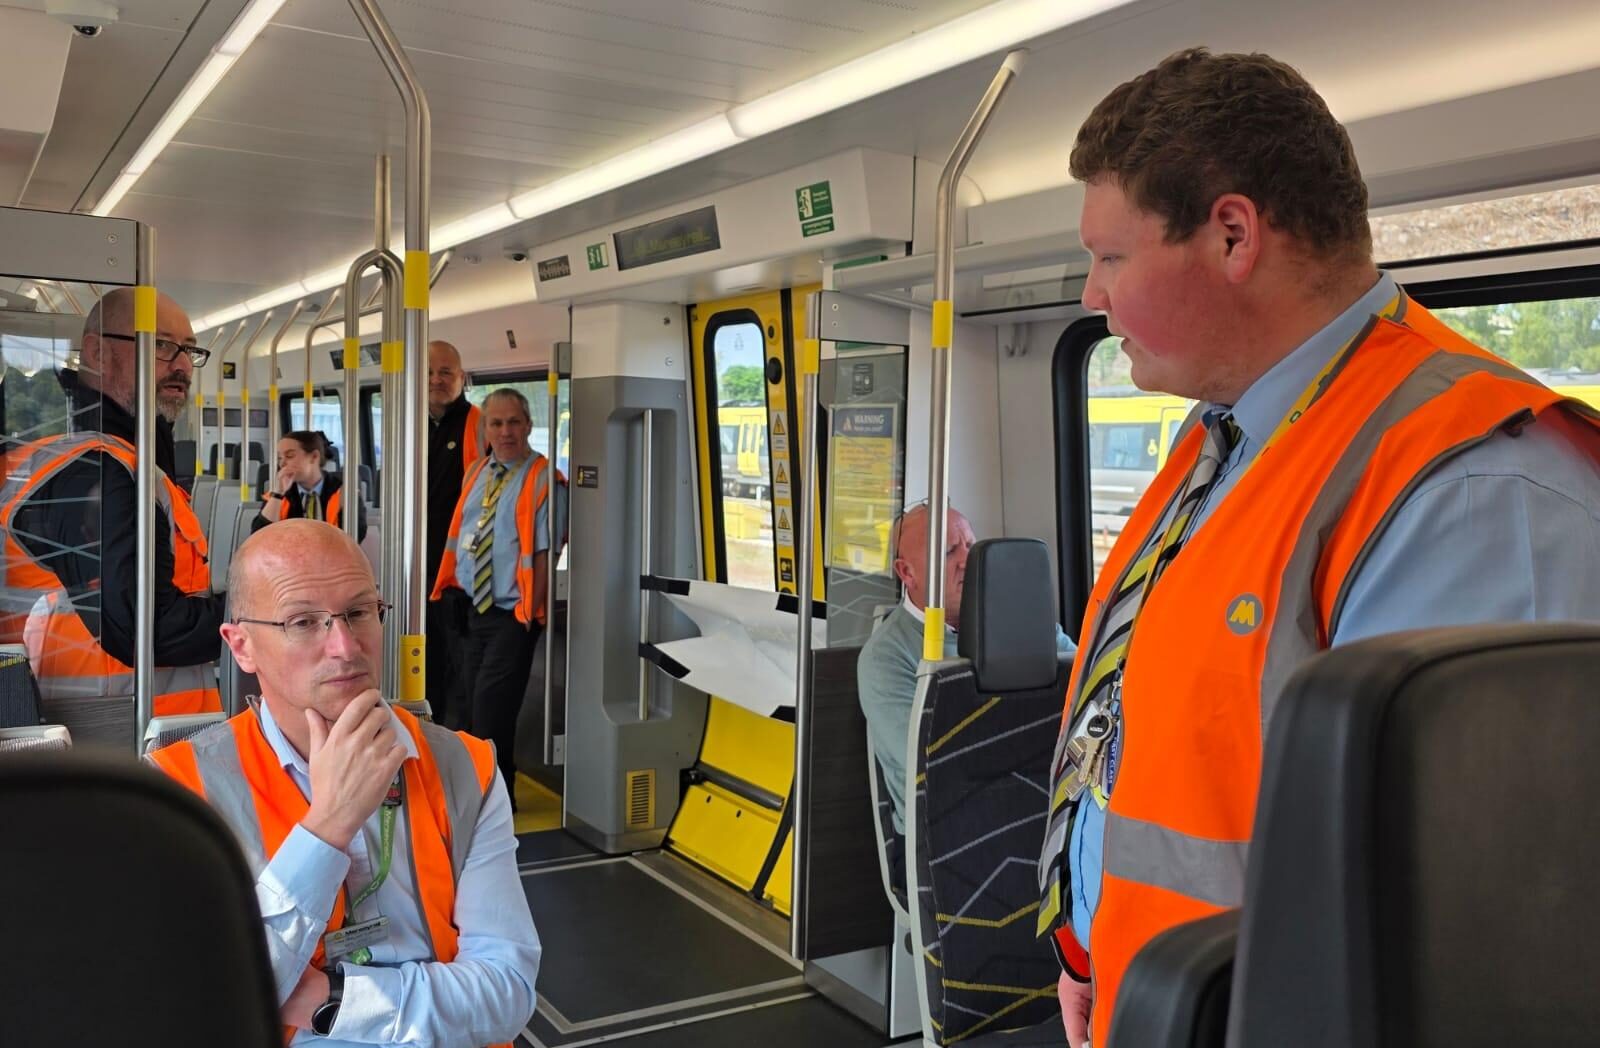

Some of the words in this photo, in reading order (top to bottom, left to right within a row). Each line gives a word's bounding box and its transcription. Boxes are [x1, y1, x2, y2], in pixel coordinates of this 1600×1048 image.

[854, 414, 885, 424] WARNING
[1229, 599, 1255, 627] M
[1108, 759, 1116, 784] CLASS
